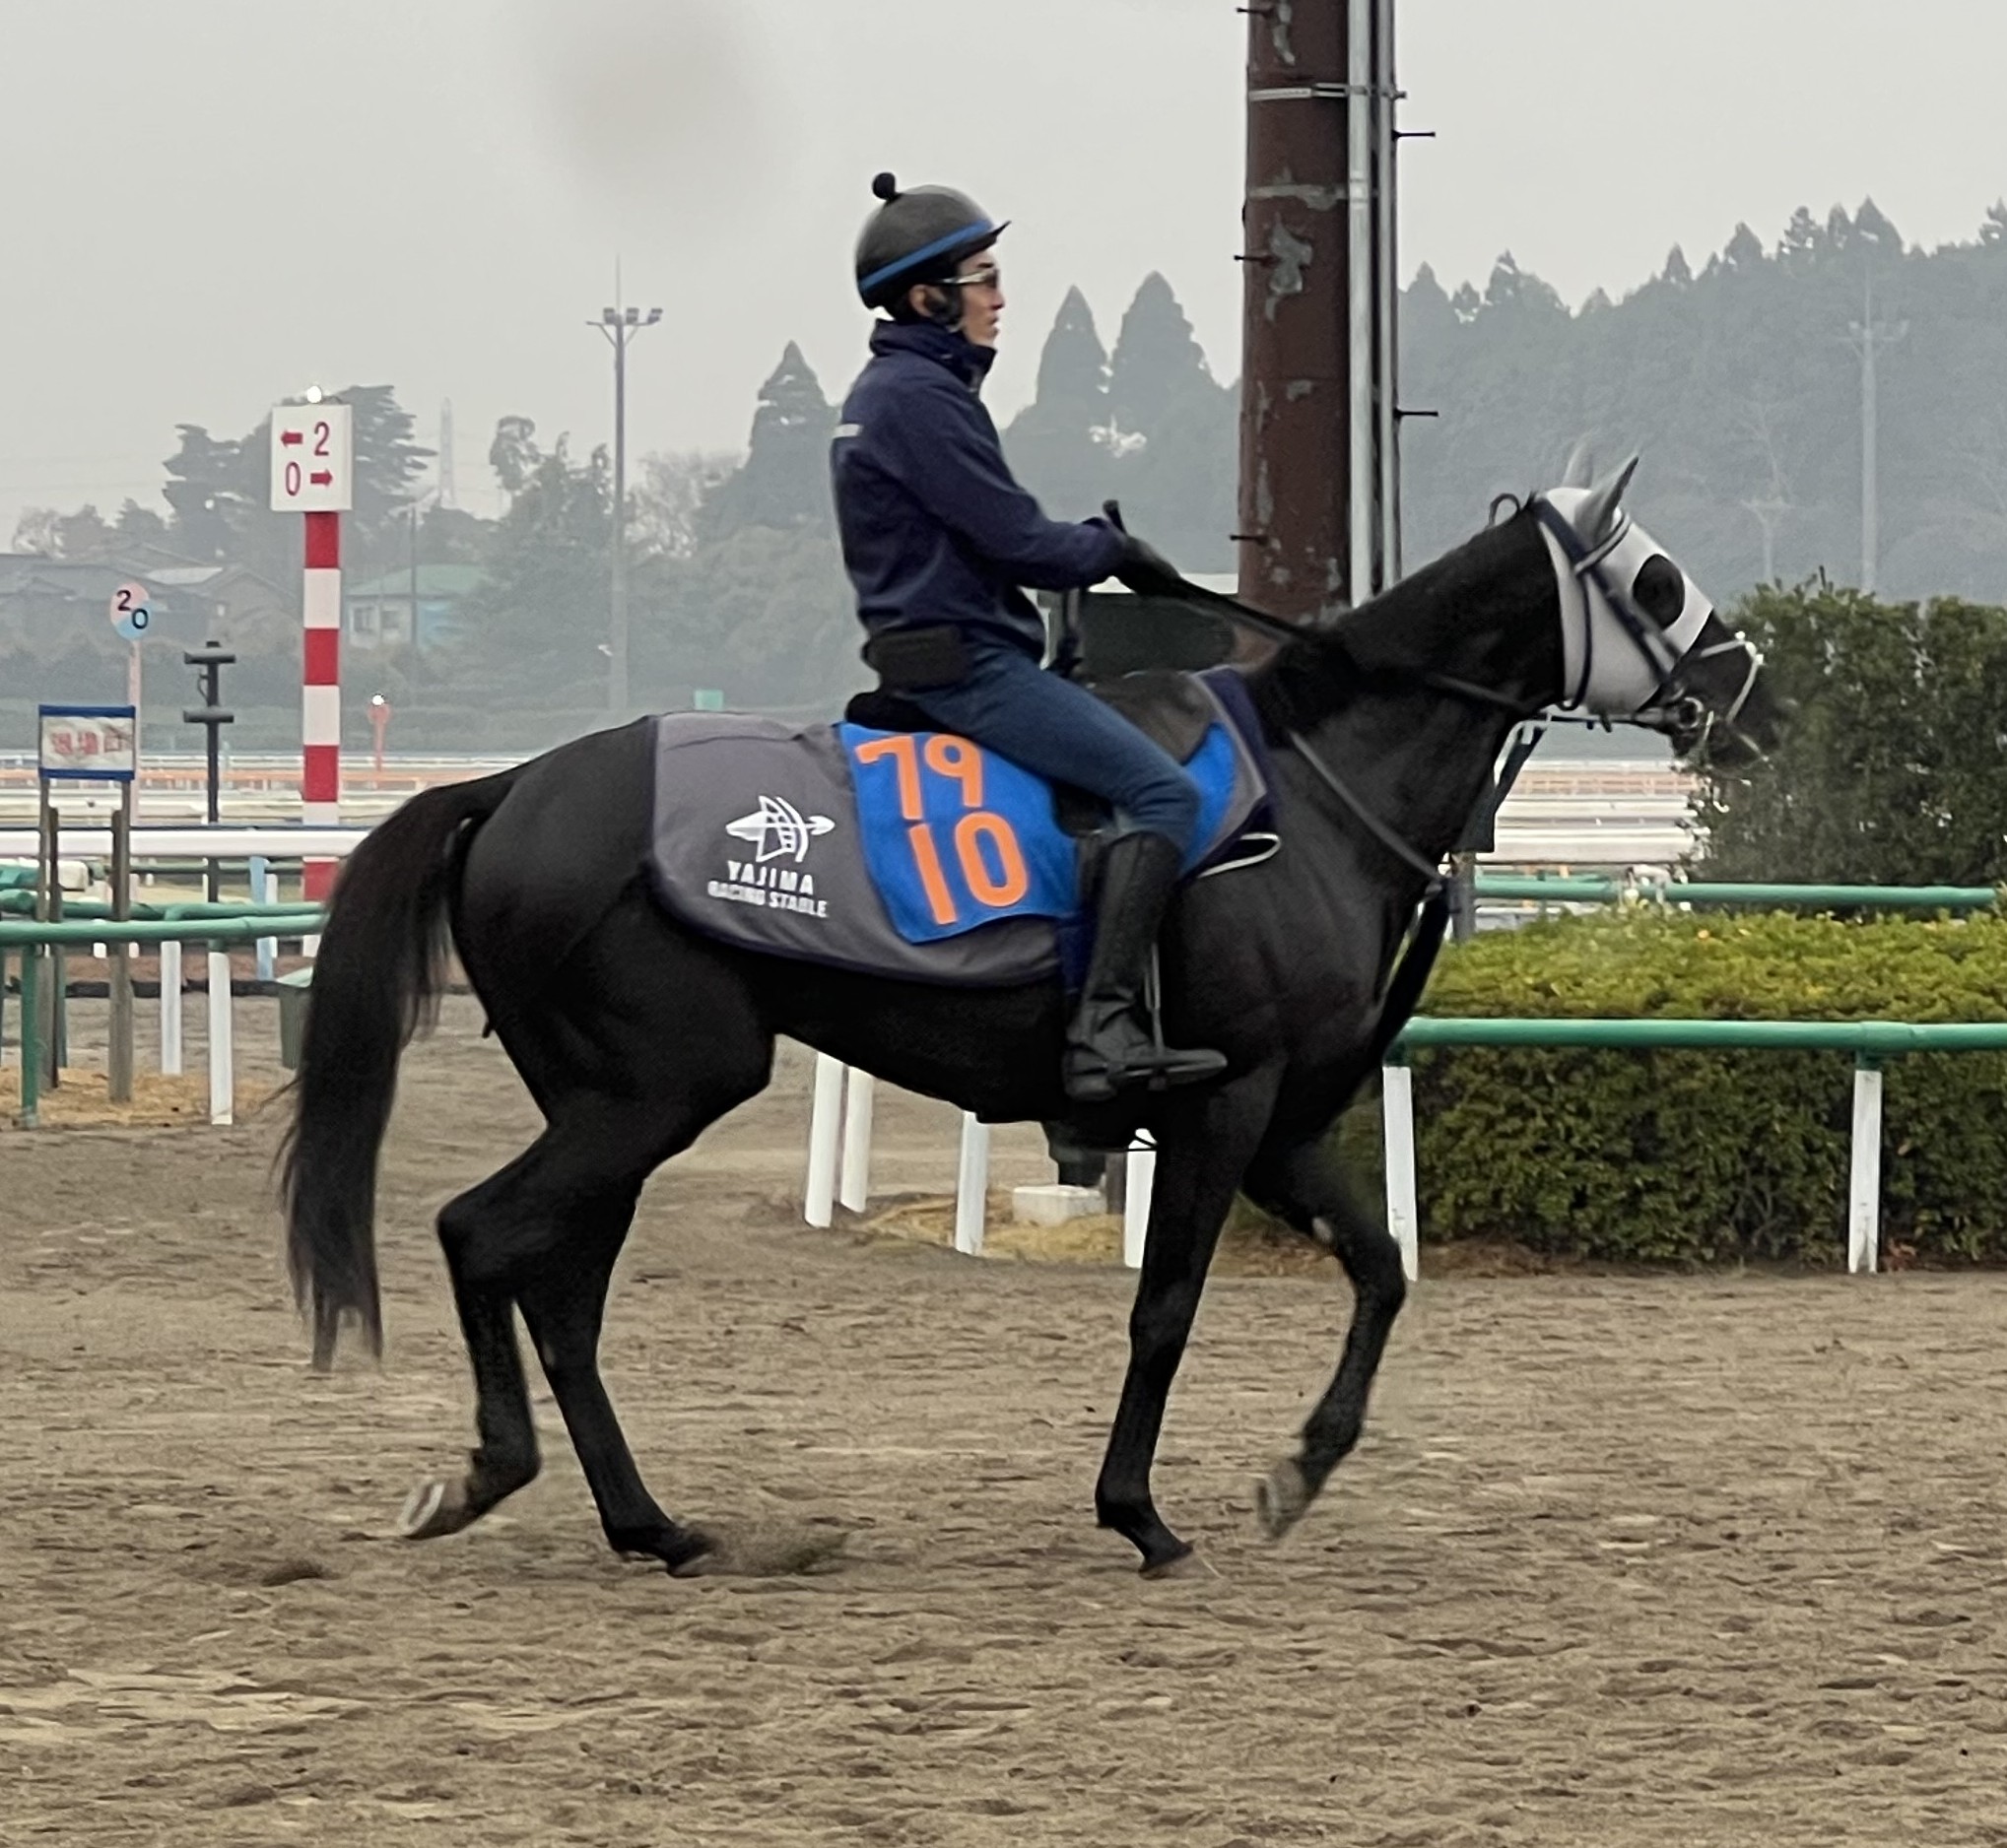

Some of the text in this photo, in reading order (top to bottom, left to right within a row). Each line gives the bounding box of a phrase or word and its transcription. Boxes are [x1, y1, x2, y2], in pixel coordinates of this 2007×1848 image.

[314, 421, 330, 456] 2
[285, 461, 301, 496] 0
[116, 589, 131, 612] 2
[131, 608, 149, 629] 0
[854, 733, 983, 821] 79
[727, 860, 814, 895] YAJIMA
[908, 811, 1029, 926] 10
